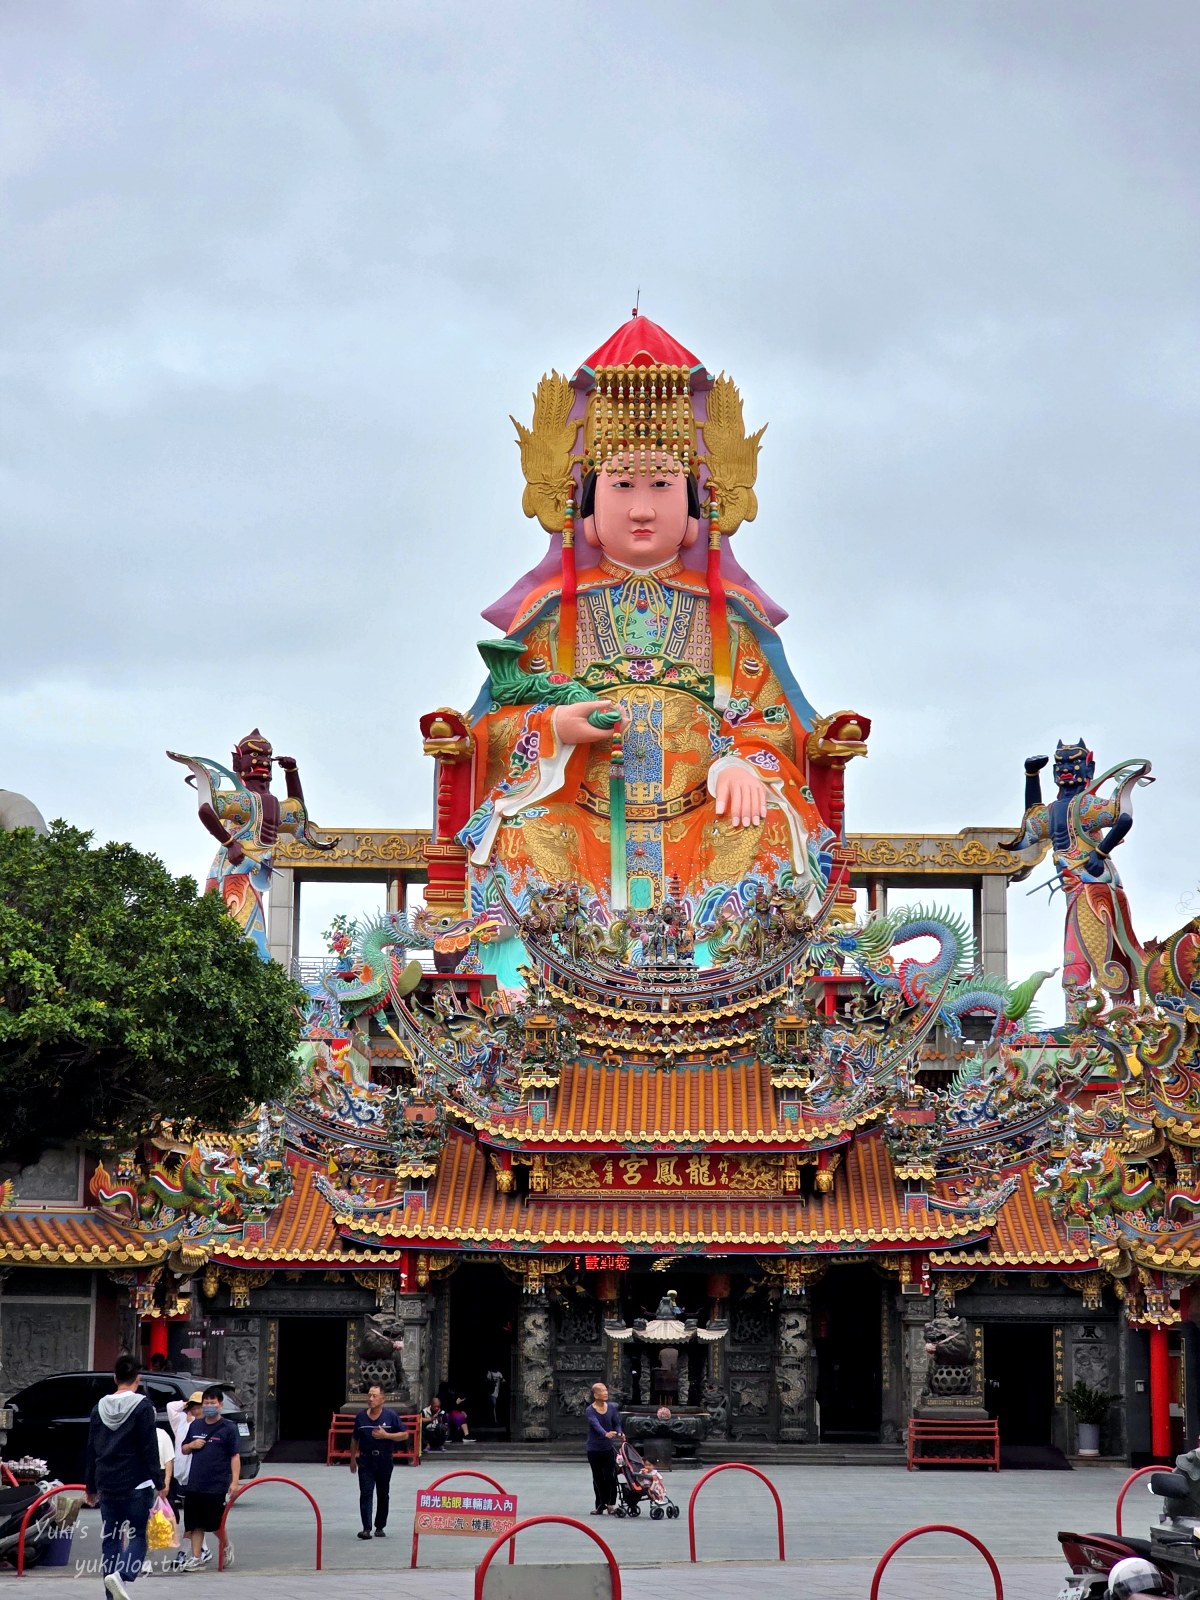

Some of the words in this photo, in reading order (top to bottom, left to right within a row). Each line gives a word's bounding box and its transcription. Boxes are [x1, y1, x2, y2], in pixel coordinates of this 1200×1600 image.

[717, 1160, 730, 1185] 竹南
[420, 1494, 513, 1512] 開光點眼車輛請入內
